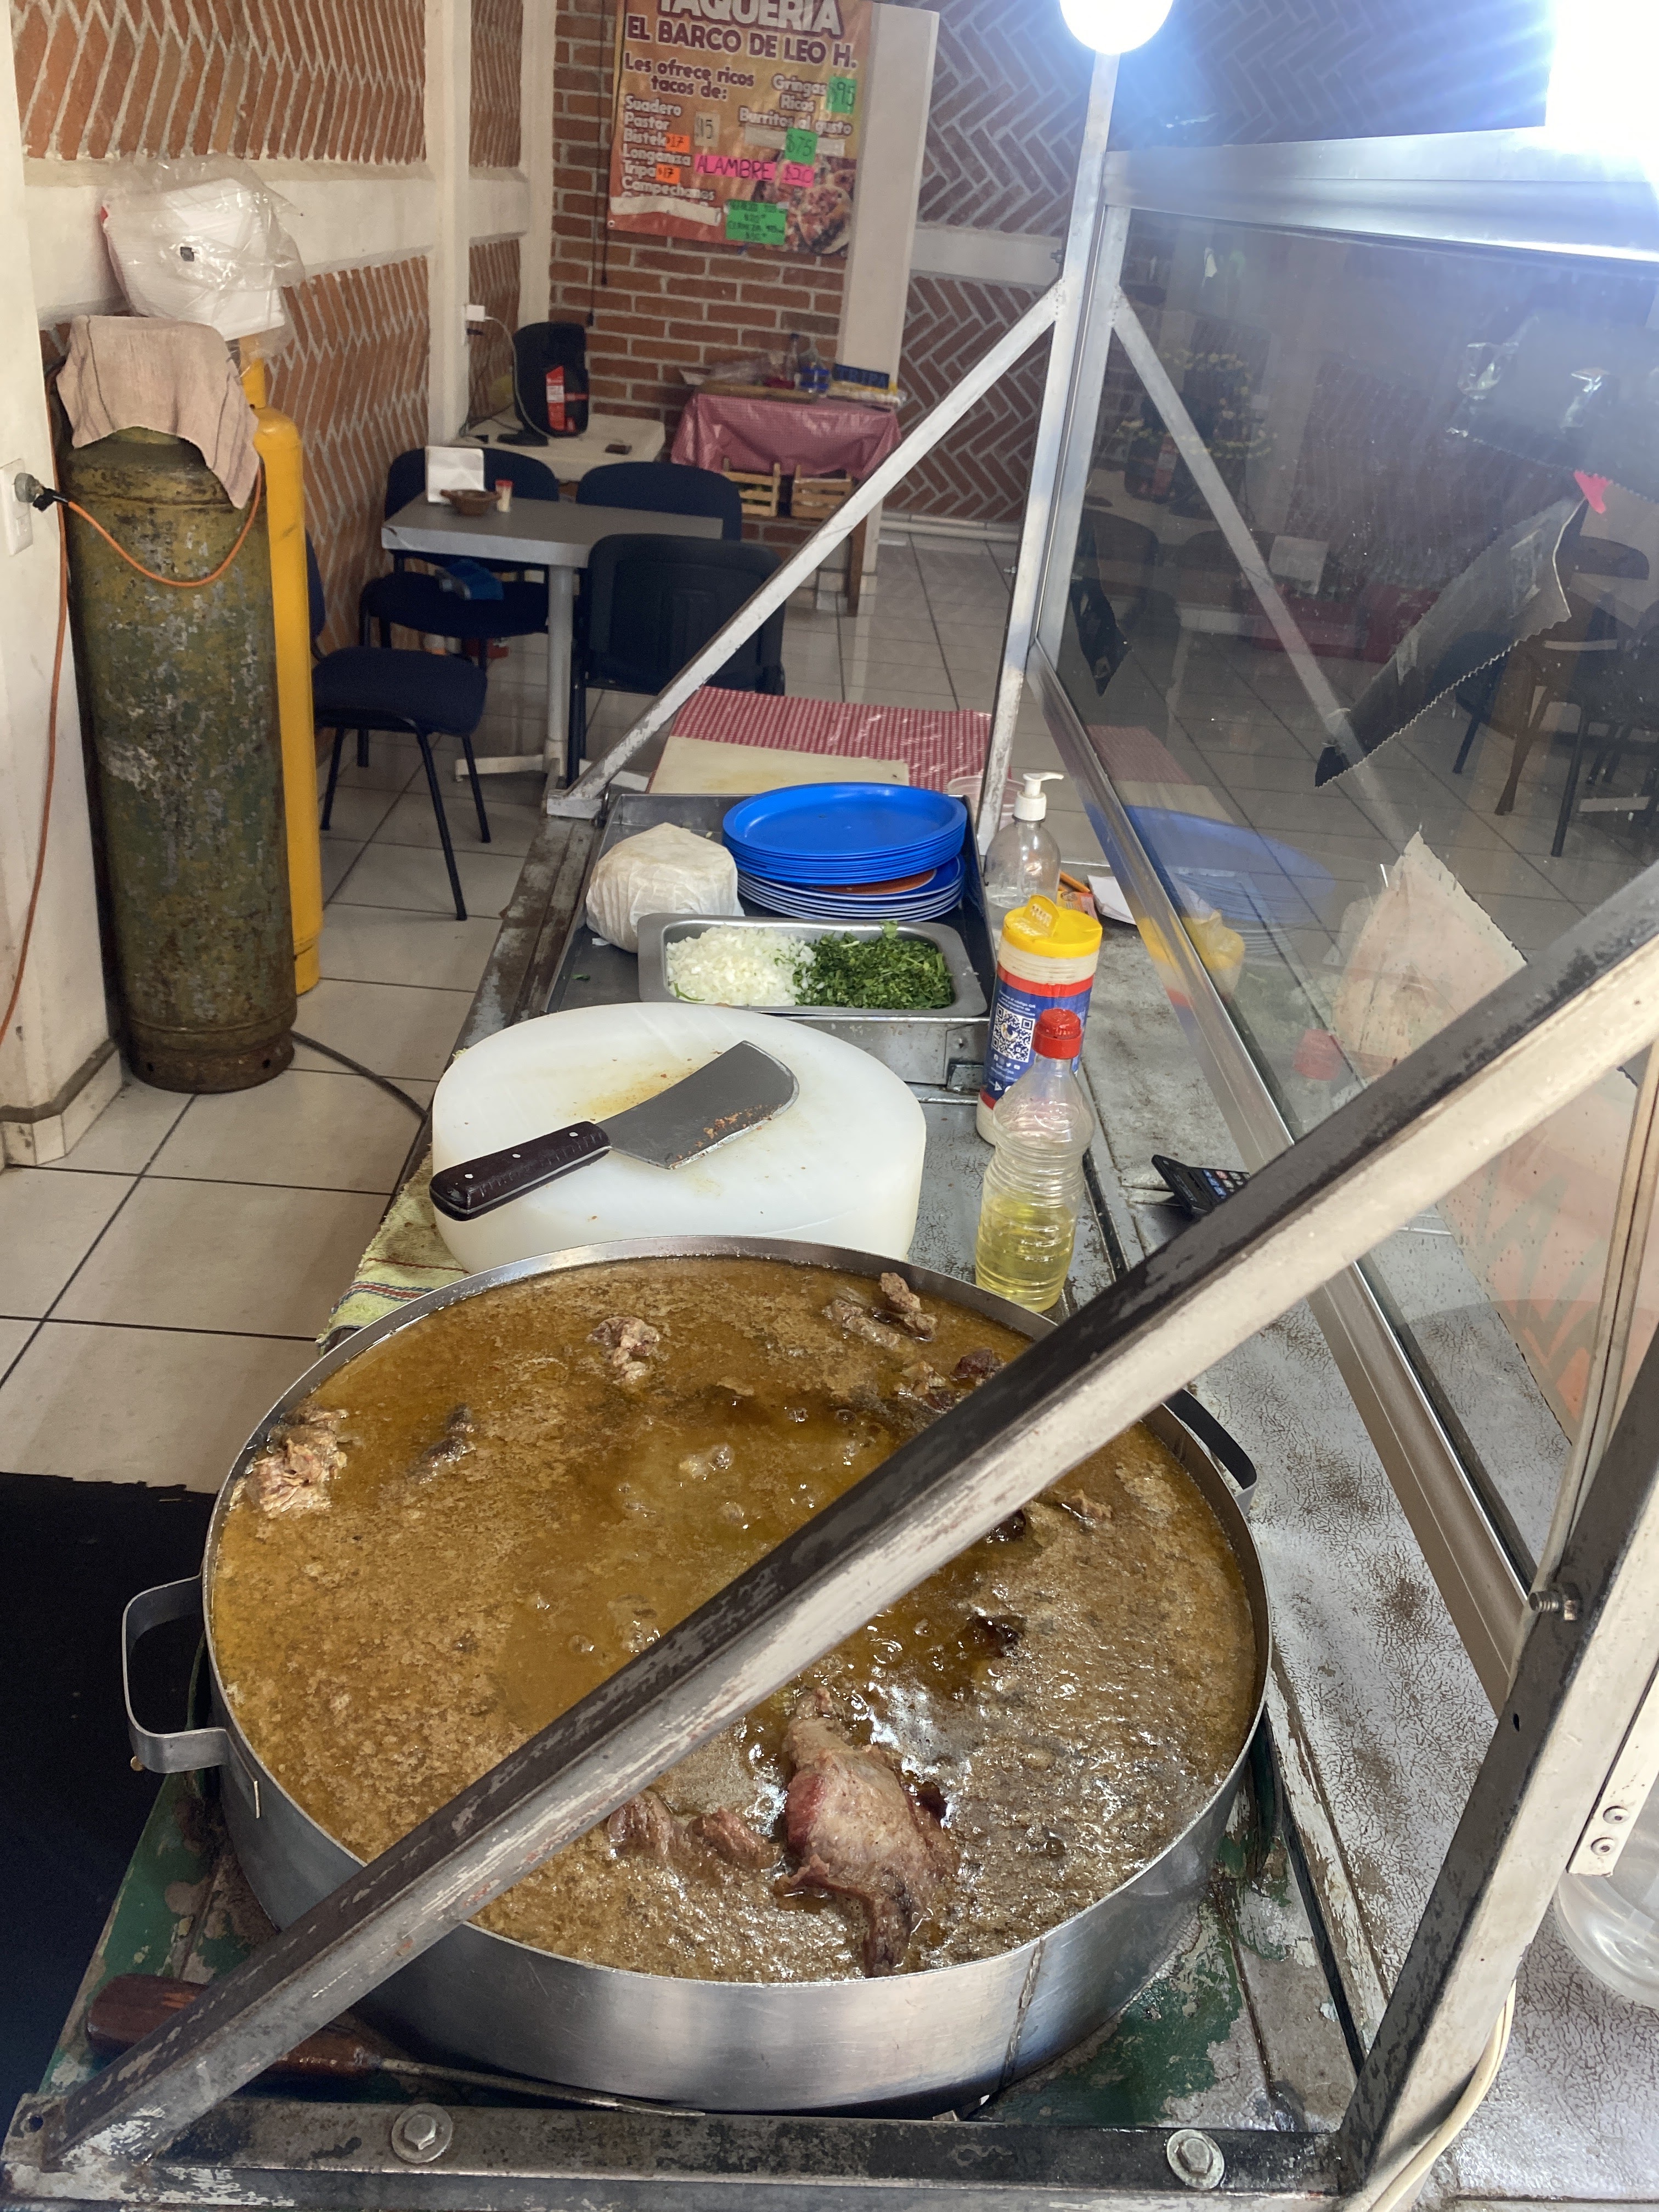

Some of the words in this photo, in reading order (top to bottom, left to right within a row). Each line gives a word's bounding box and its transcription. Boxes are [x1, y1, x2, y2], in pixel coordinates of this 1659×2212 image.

[627, 15, 651, 41] EL
[658, 20, 741, 53] BARCO
[749, 32, 778, 58] DE
[783, 37, 826, 64] LEO
[832, 43, 857, 67] H.
[625, 52, 652, 72] Les
[657, 59, 711, 81] ofrece
[717, 66, 754, 87] ricos
[651, 75, 694, 95] tacos
[701, 81, 727, 99] de:
[772, 74, 827, 98] Gringas
[625, 95, 682, 116] Suadero
[781, 94, 815, 112] Ricos
[624, 111, 671, 131] Pastor
[739, 106, 793, 127] Burritos
[798, 115, 811, 130] al
[815, 121, 852, 136] gusto
[623, 128, 667, 146] Bistek
[623, 143, 691, 165] Longaniza
[623, 159, 657, 179] Tripa
[696, 155, 773, 180] ALAMBRE
[622, 176, 715, 201] Campechanas
